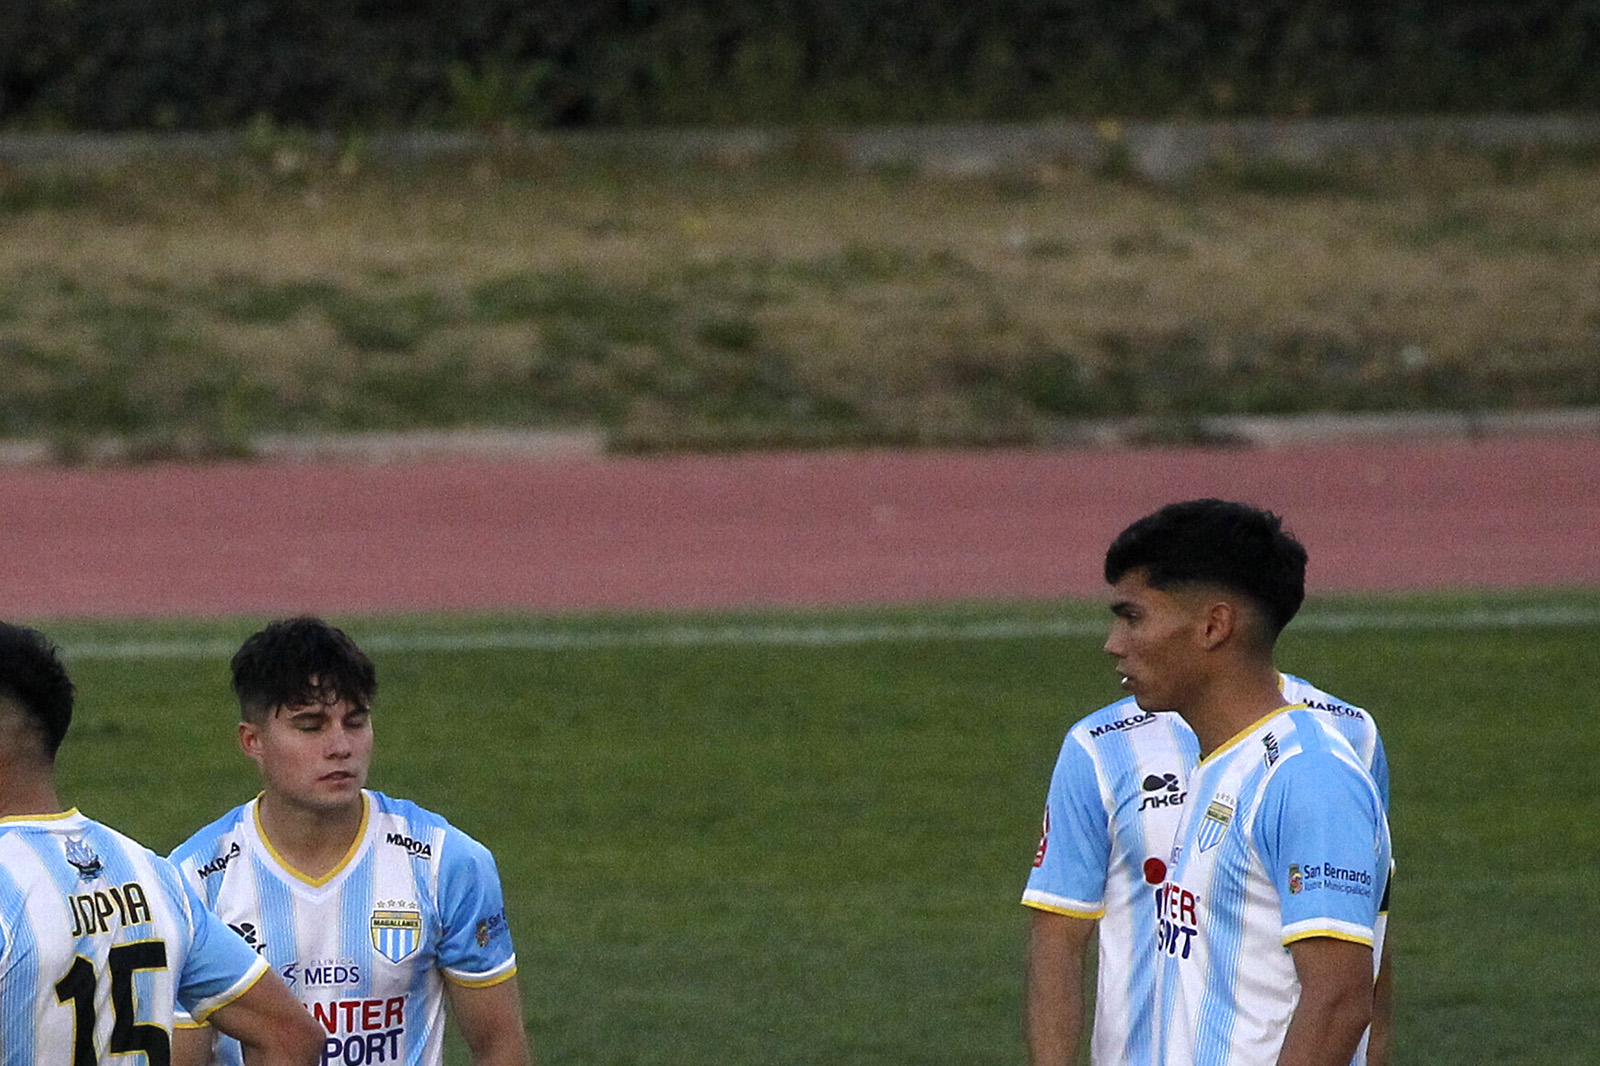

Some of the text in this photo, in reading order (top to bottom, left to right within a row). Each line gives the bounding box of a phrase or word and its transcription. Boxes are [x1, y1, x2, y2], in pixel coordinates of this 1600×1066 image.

[1089, 711, 1156, 738] MARCOA
[1304, 862, 1372, 886] San Bernardo
[304, 966, 360, 985] MEDS
[303, 996, 404, 1034] NTER
